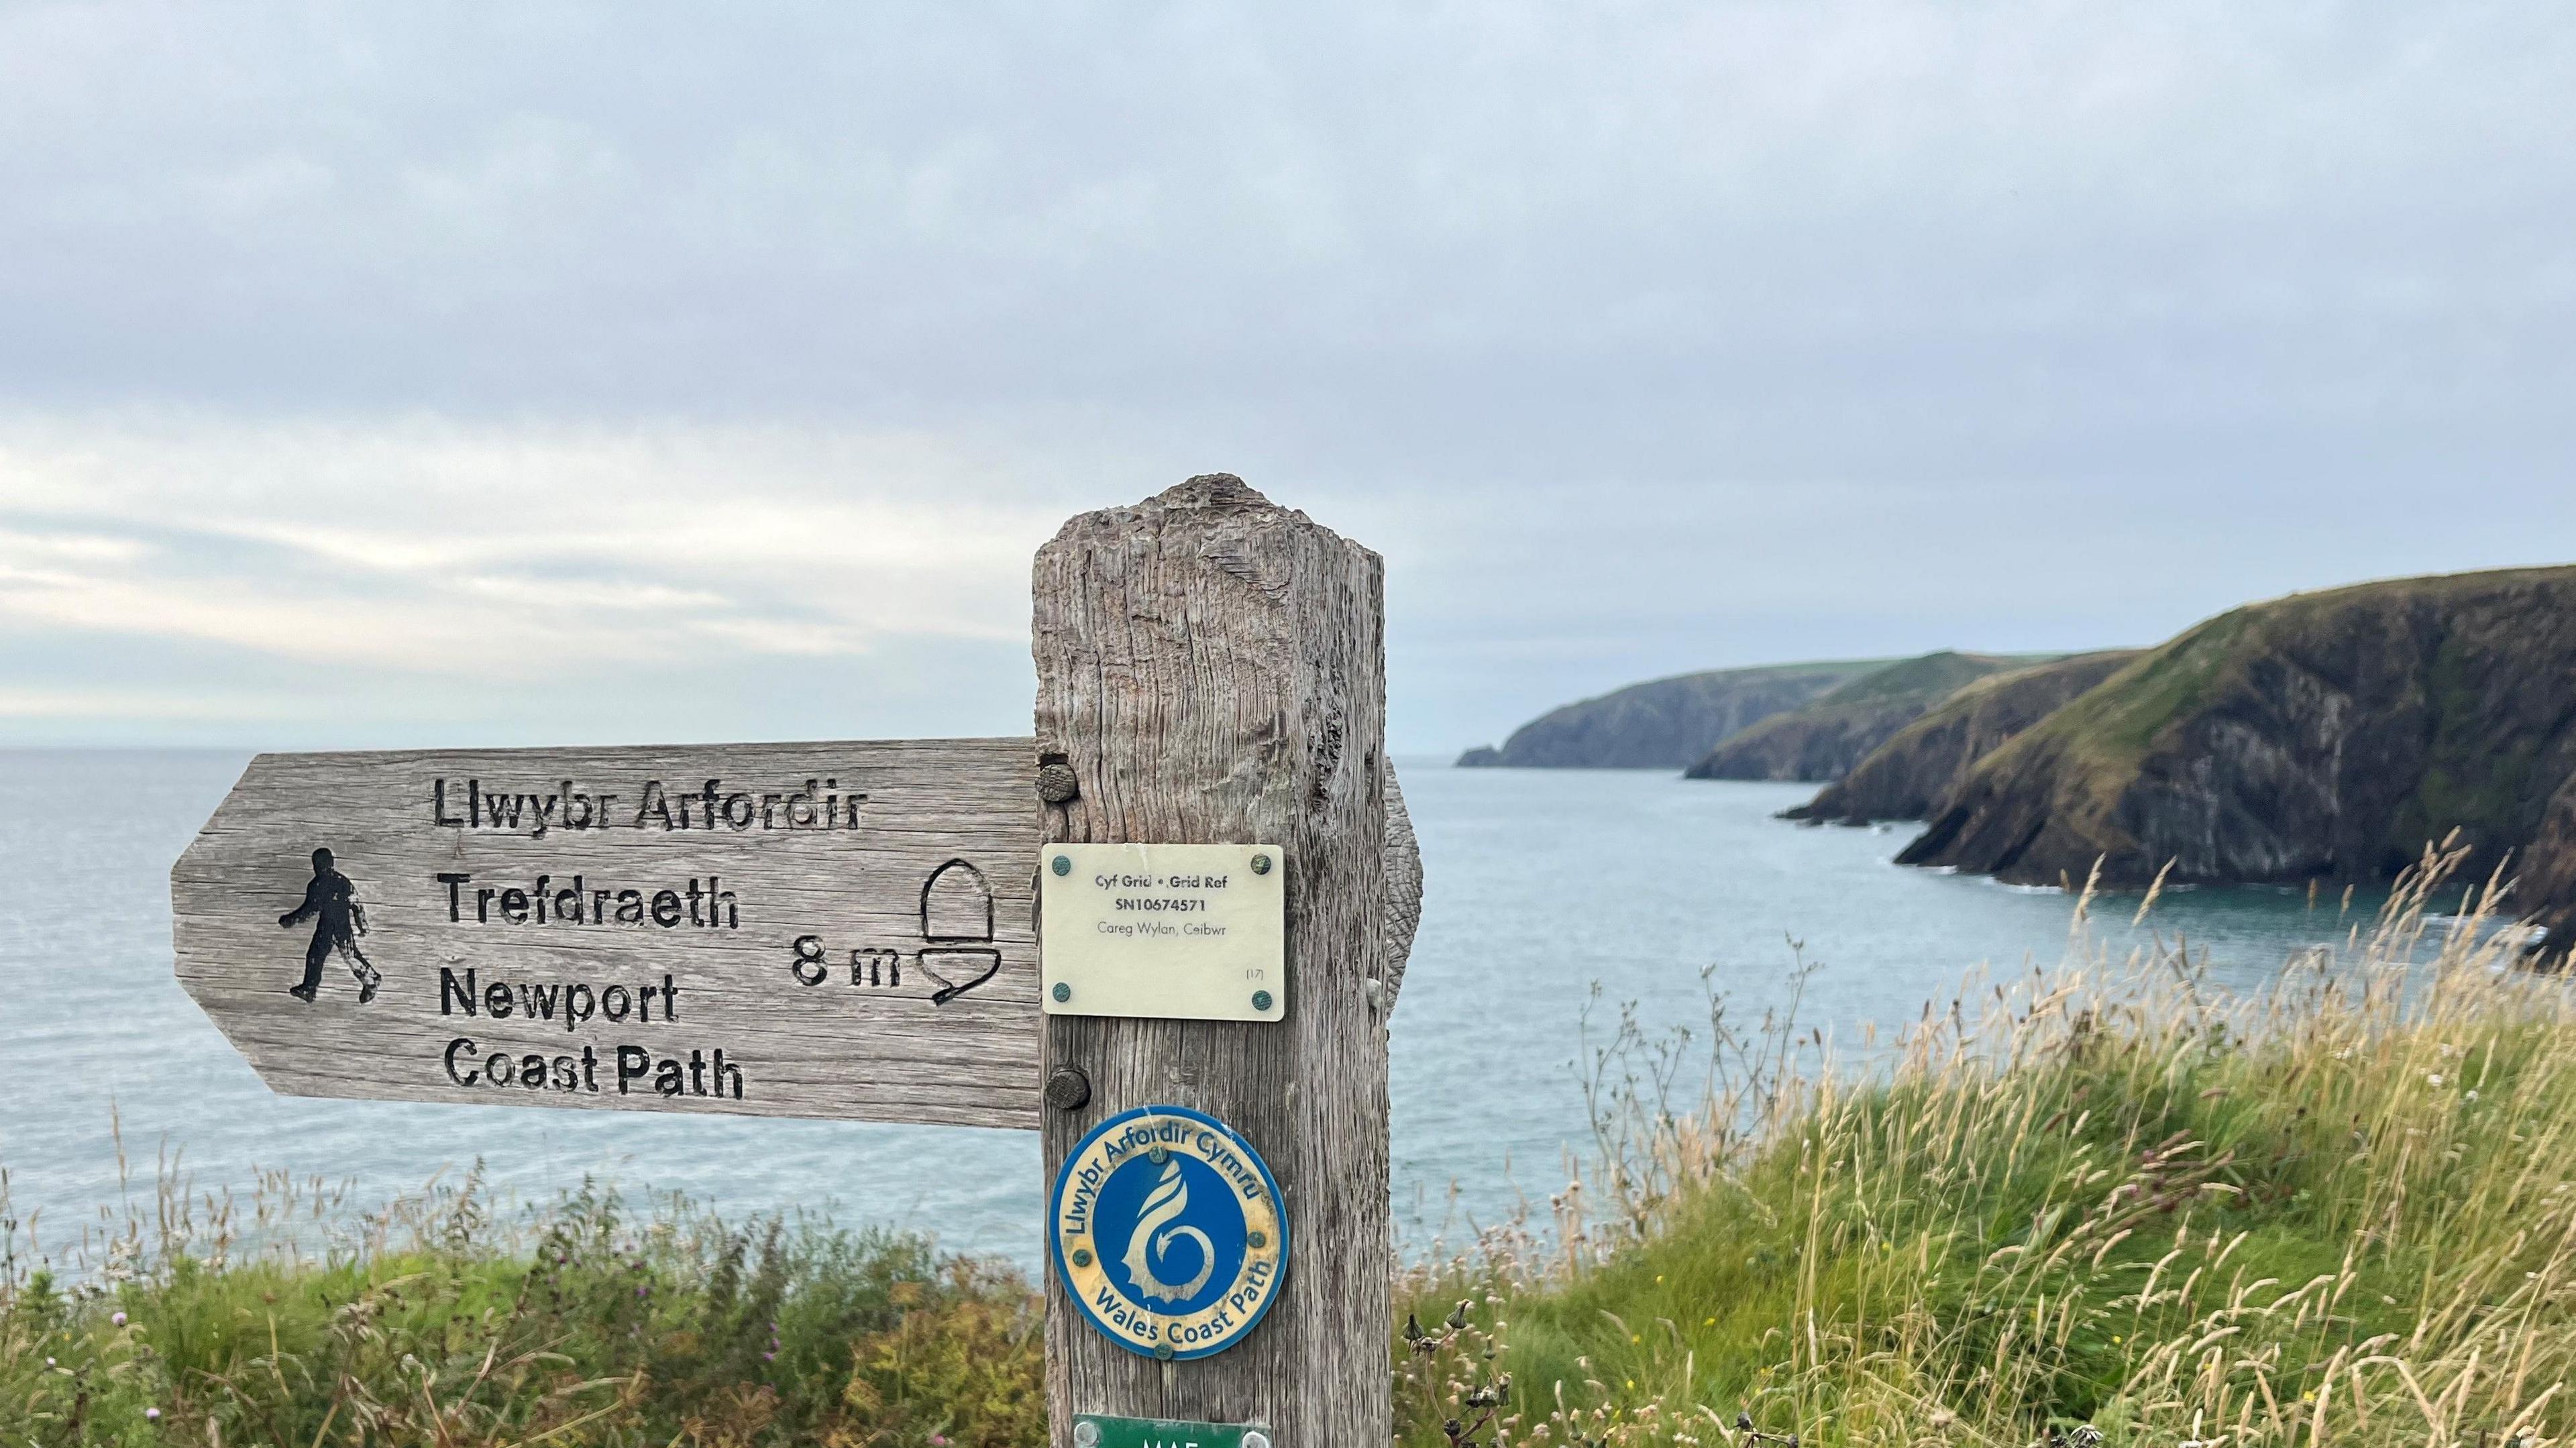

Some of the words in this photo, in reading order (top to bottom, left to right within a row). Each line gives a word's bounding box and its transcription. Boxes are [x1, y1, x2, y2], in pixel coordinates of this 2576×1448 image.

[433, 779, 617, 840] Llwybr
[636, 779, 868, 832] Arfordir
[437, 873, 739, 929] Trefdraeth
[1095, 874, 1118, 890] Cyf
[1122, 875, 1152, 887] Grid
[1169, 875, 1199, 889] Grid
[1205, 875, 1228, 889] Ref
[1116, 898, 1205, 911] SN10674571
[1097, 921, 1132, 937] Careg
[1137, 921, 1179, 938] Wylan,
[1183, 922, 1226, 936] Ceibwr
[792, 934, 828, 987] 8
[851, 948, 900, 987] m
[439, 967, 680, 1032] Newport
[443, 1038, 599, 1093] Coast
[616, 1044, 743, 1100] Path
[1065, 1157, 1104, 1234] Llwybr
[1104, 1121, 1191, 1162] Arfordir
[1196, 1131, 1260, 1201] Cymru
[1095, 1286, 1159, 1341] Wales
[1167, 1311, 1234, 1344] Coast
[1230, 1261, 1271, 1315] Path
